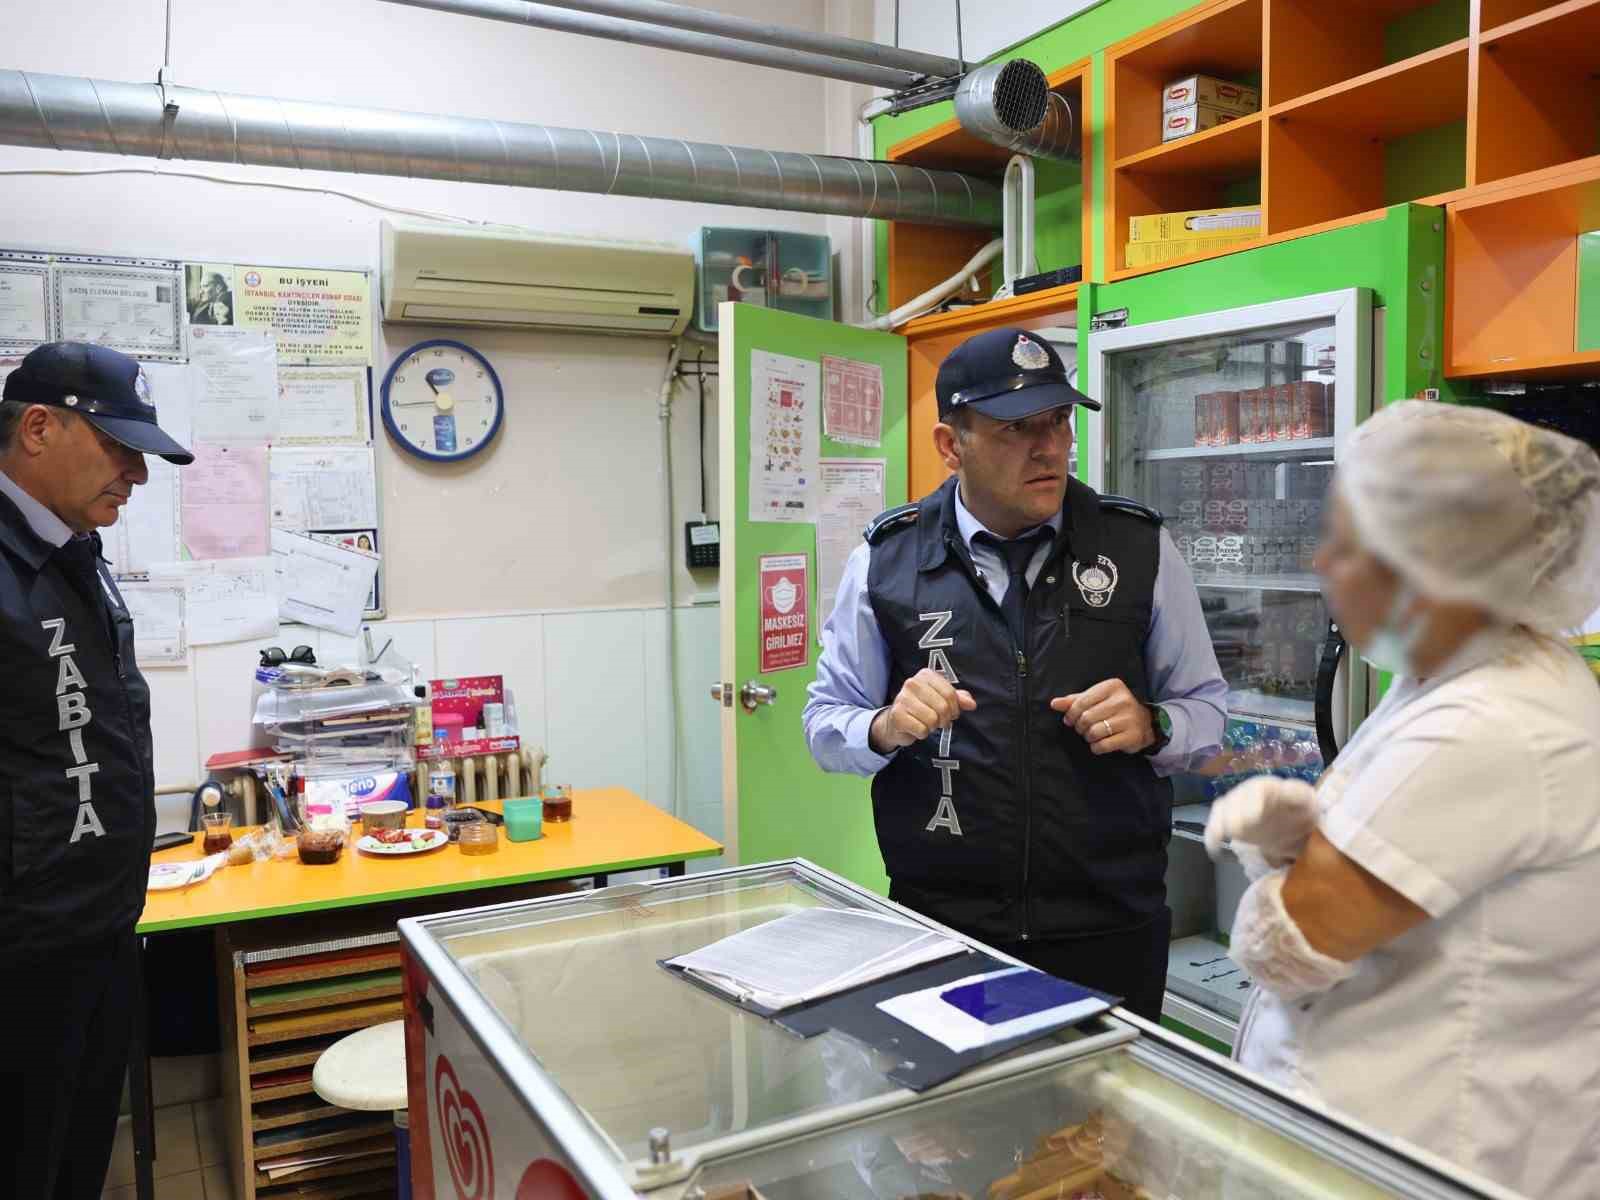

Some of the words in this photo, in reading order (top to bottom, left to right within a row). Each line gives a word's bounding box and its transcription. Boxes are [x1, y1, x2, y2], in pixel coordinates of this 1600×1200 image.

[279, 277, 293, 285] BU
[296, 277, 329, 287] İŞYERİ
[245, 289, 276, 298] İSTANBUL
[392, 400, 399, 408] 9
[418, 440, 426, 448] 7
[465, 437, 473, 445] 5
[764, 612, 805, 632] MASKESİZ
[766, 632, 804, 651] GİRİLMEZ
[918, 610, 963, 836] ZAITA
[41, 618, 106, 844] ZABITA
